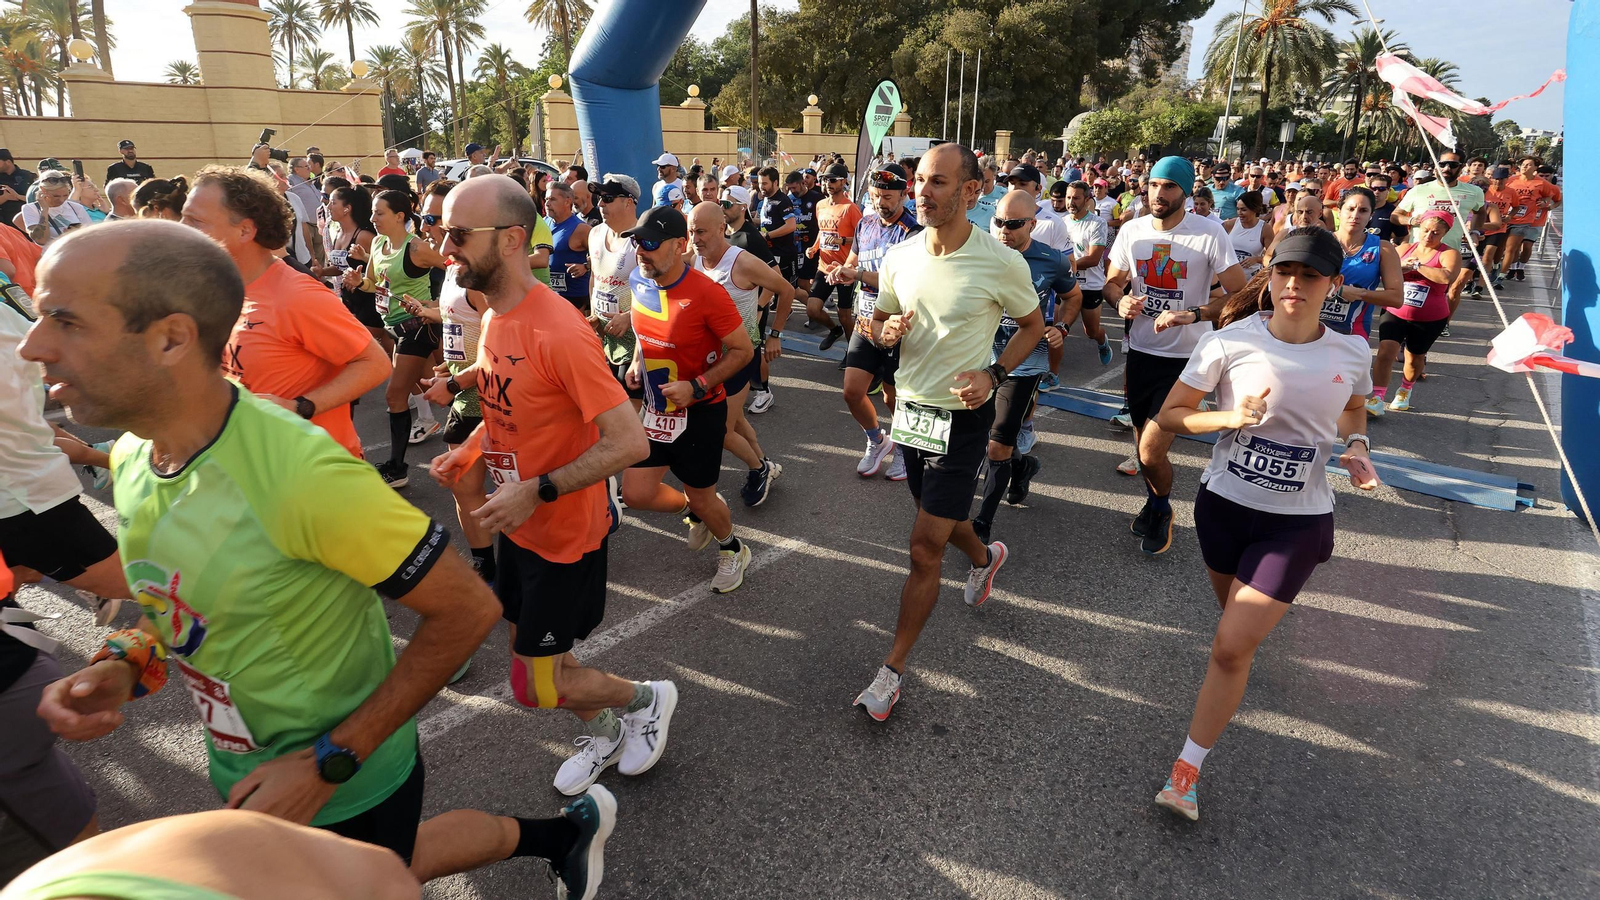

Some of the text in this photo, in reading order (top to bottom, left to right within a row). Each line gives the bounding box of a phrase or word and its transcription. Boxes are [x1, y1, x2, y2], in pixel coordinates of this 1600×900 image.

[1147, 296, 1171, 311] 596
[656, 417, 676, 431] 410
[911, 416, 931, 435] 23
[909, 437, 943, 451] MIZUNO
[1242, 450, 1299, 479] 1055
[1252, 477, 1299, 492] MIZUNO
